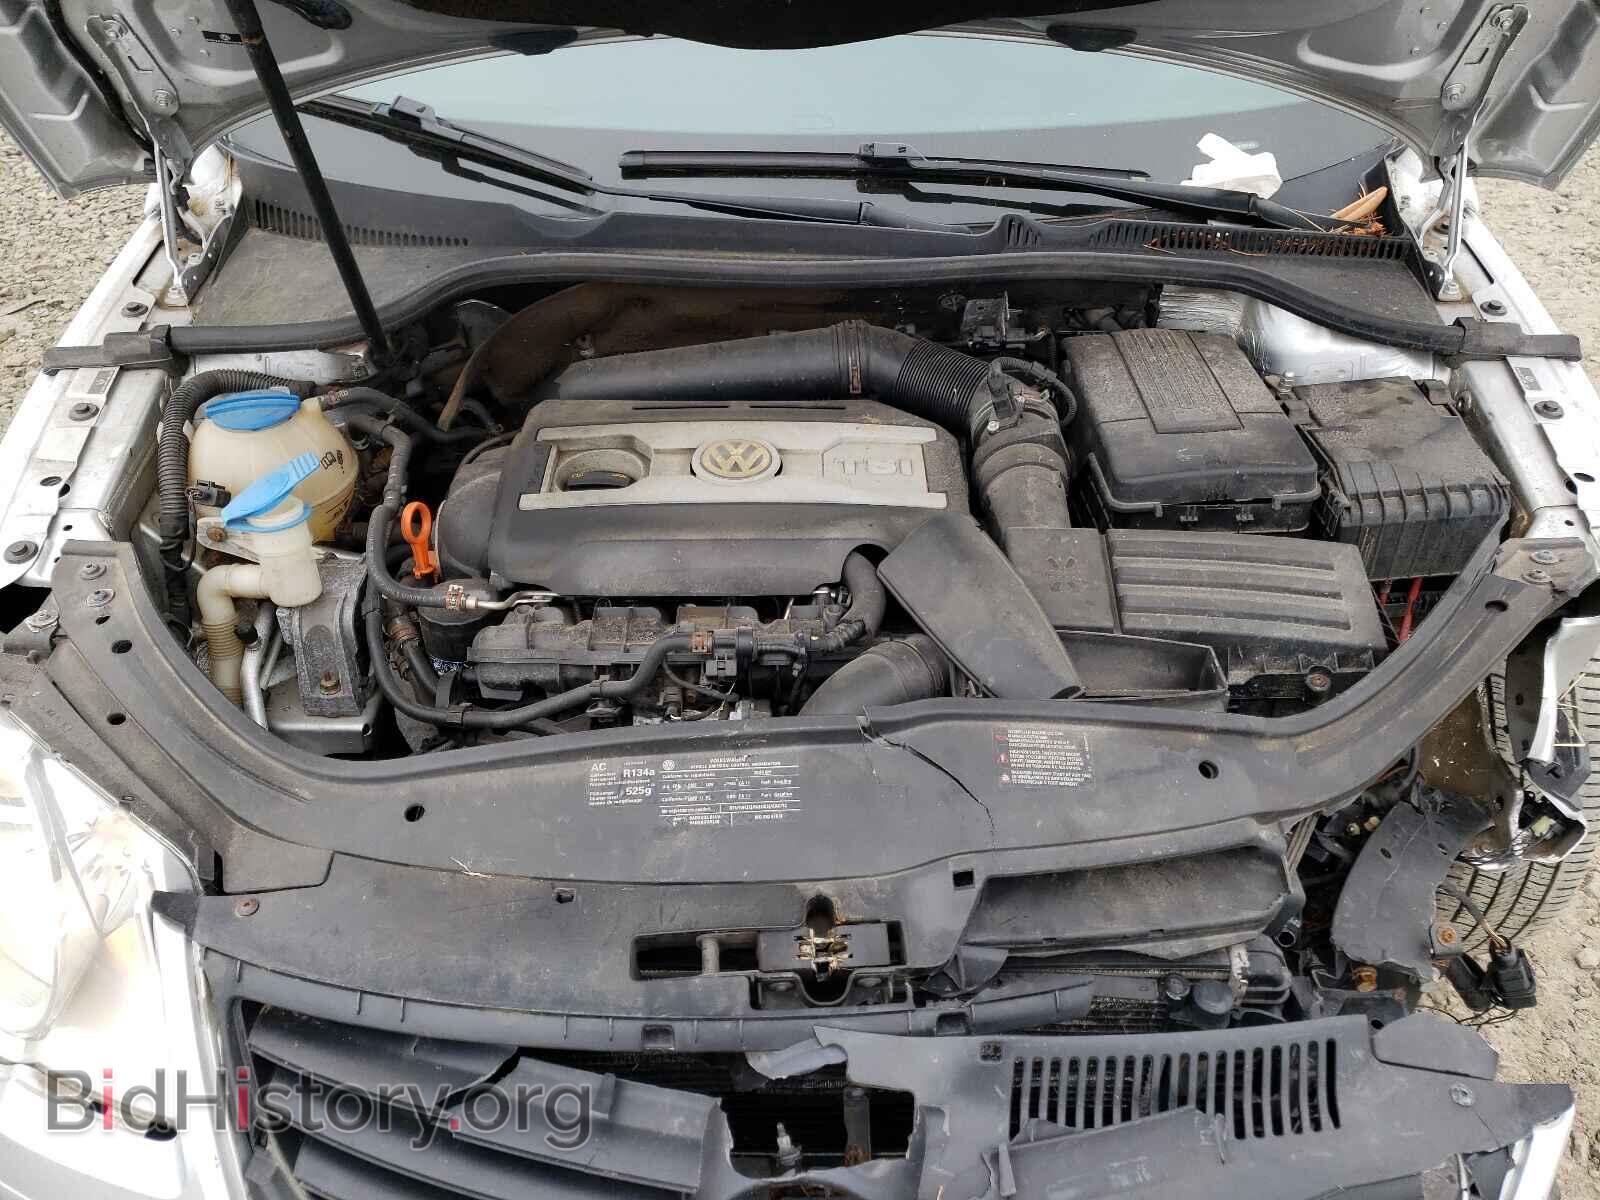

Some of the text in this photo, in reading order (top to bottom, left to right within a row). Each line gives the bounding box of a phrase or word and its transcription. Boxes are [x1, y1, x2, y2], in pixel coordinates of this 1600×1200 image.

[833, 457, 913, 476] TSI
[591, 762, 607, 772] AC
[623, 768, 655, 778] R134a
[625, 786, 652, 797] 525g
